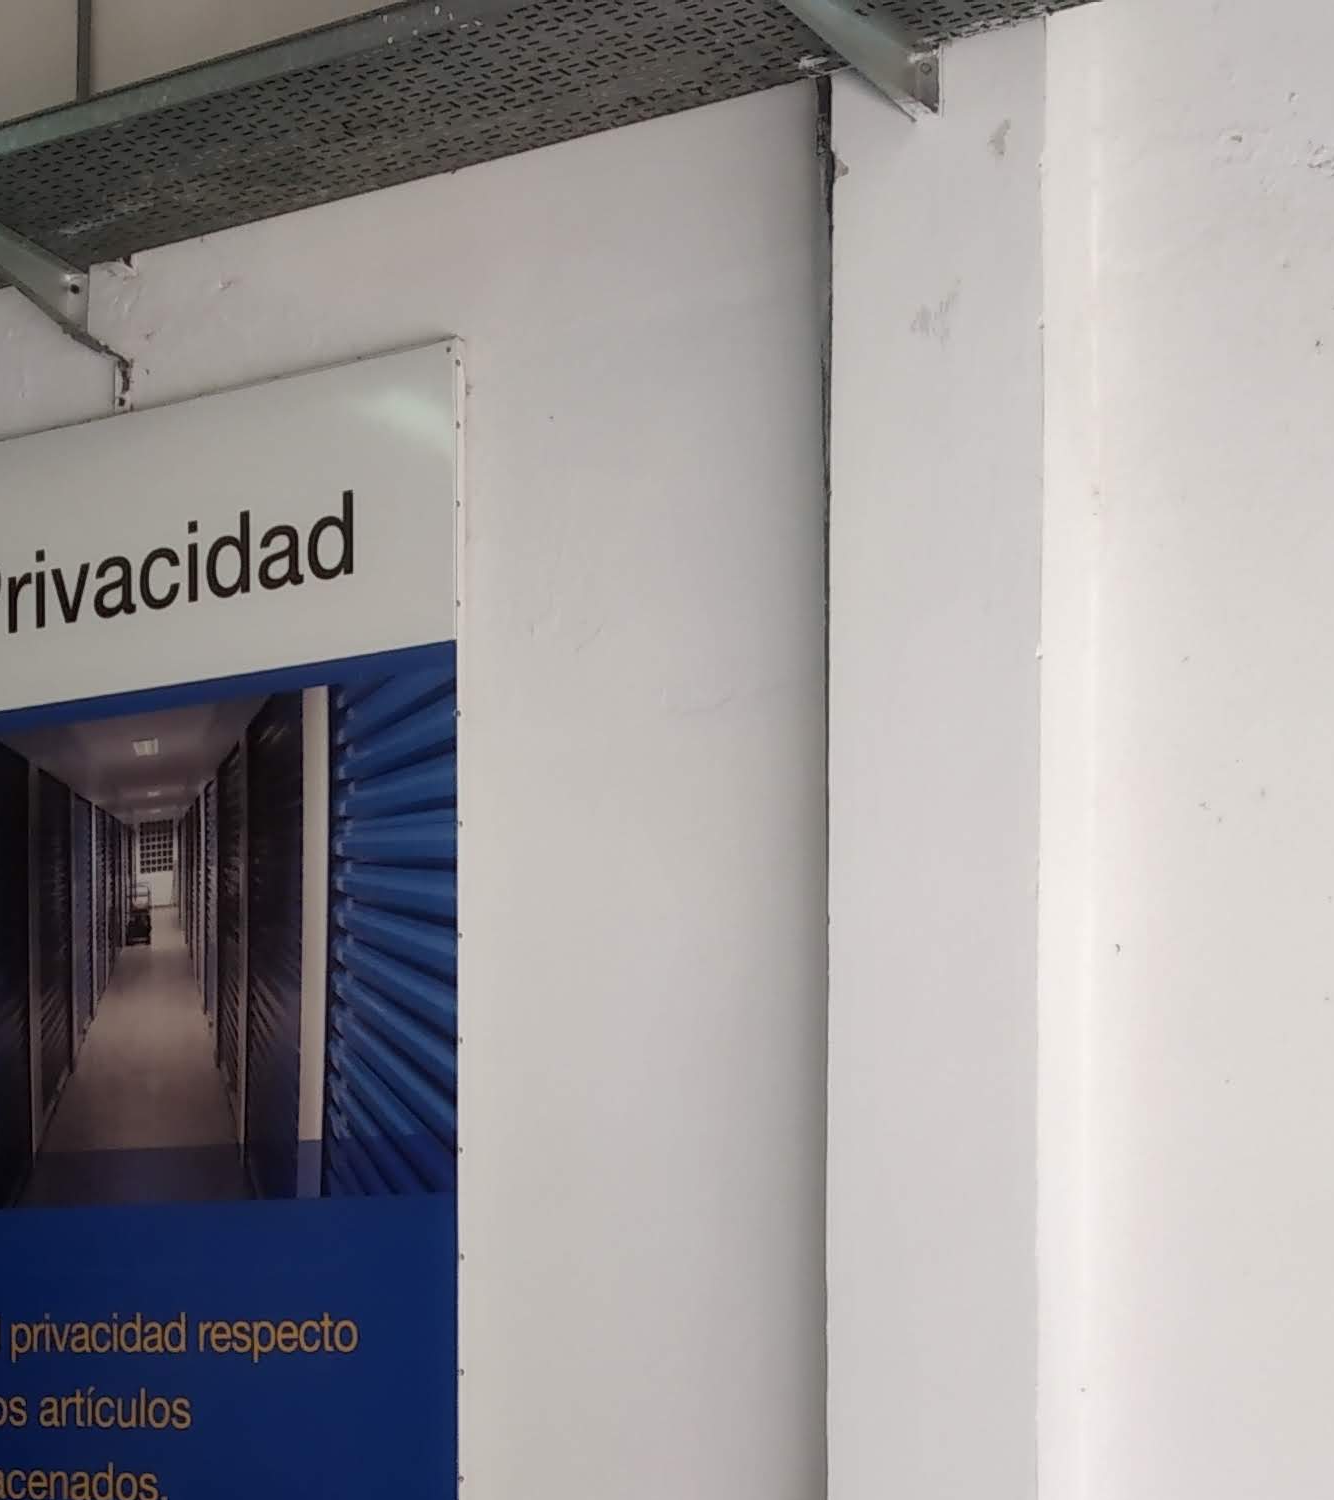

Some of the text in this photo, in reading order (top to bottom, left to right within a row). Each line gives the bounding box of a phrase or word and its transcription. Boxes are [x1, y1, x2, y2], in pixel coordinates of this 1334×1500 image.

[10, 1311, 187, 1363] privacidad
[198, 1312, 359, 1363] respecto
[39, 1386, 192, 1430] artículos
